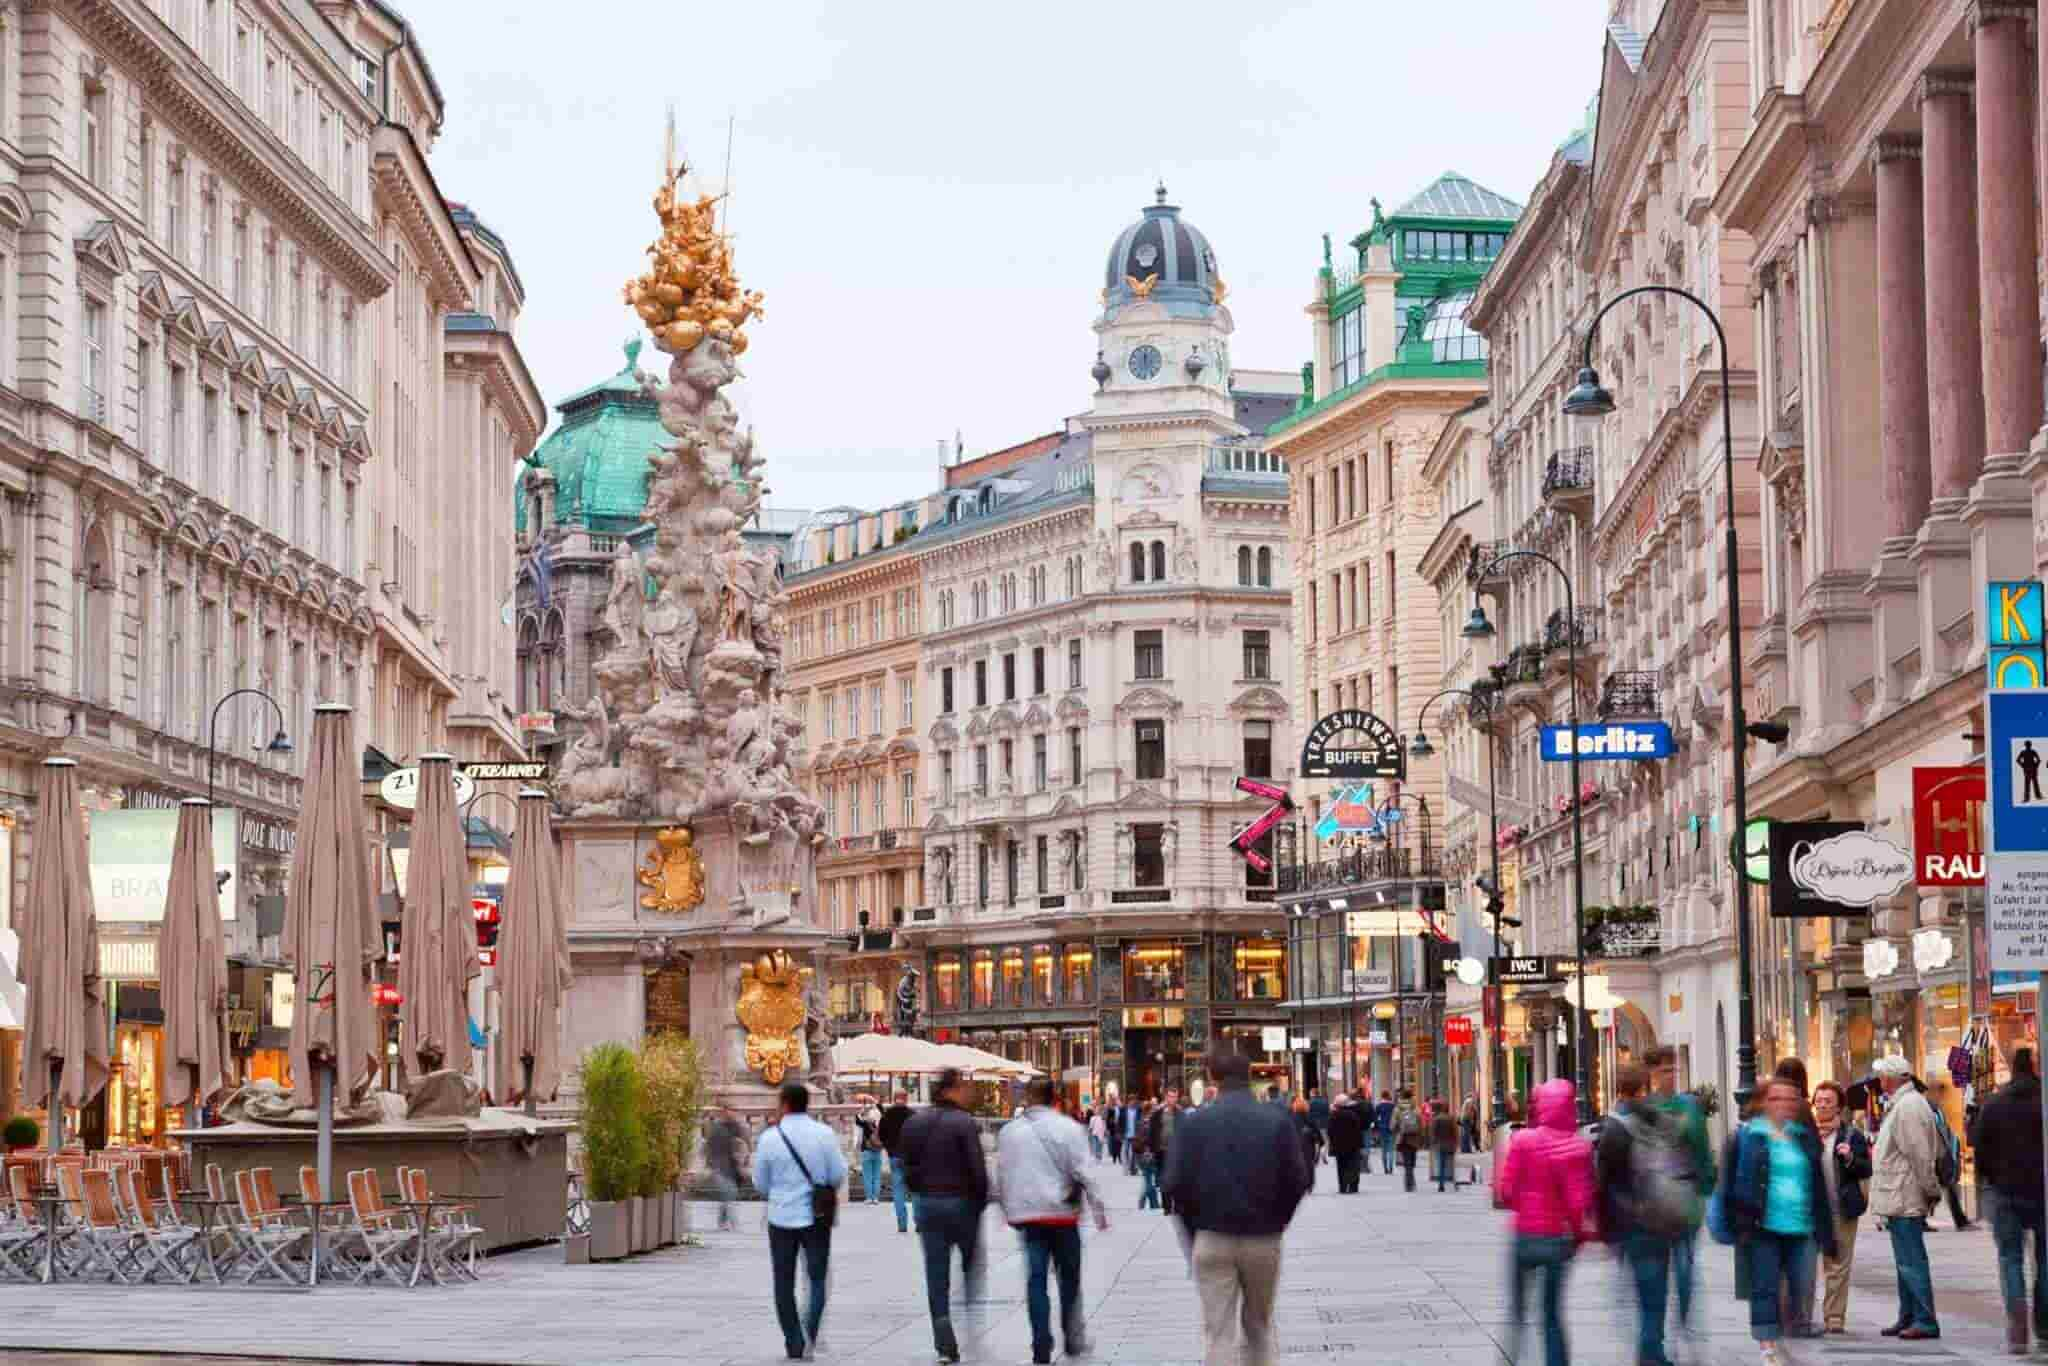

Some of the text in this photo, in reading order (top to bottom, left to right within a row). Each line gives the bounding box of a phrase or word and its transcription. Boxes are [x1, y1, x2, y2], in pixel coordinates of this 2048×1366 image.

[1554, 727, 1656, 754] Berlitz
[1325, 751, 1378, 764] BUFFET
[1511, 959, 1537, 972] IWC
